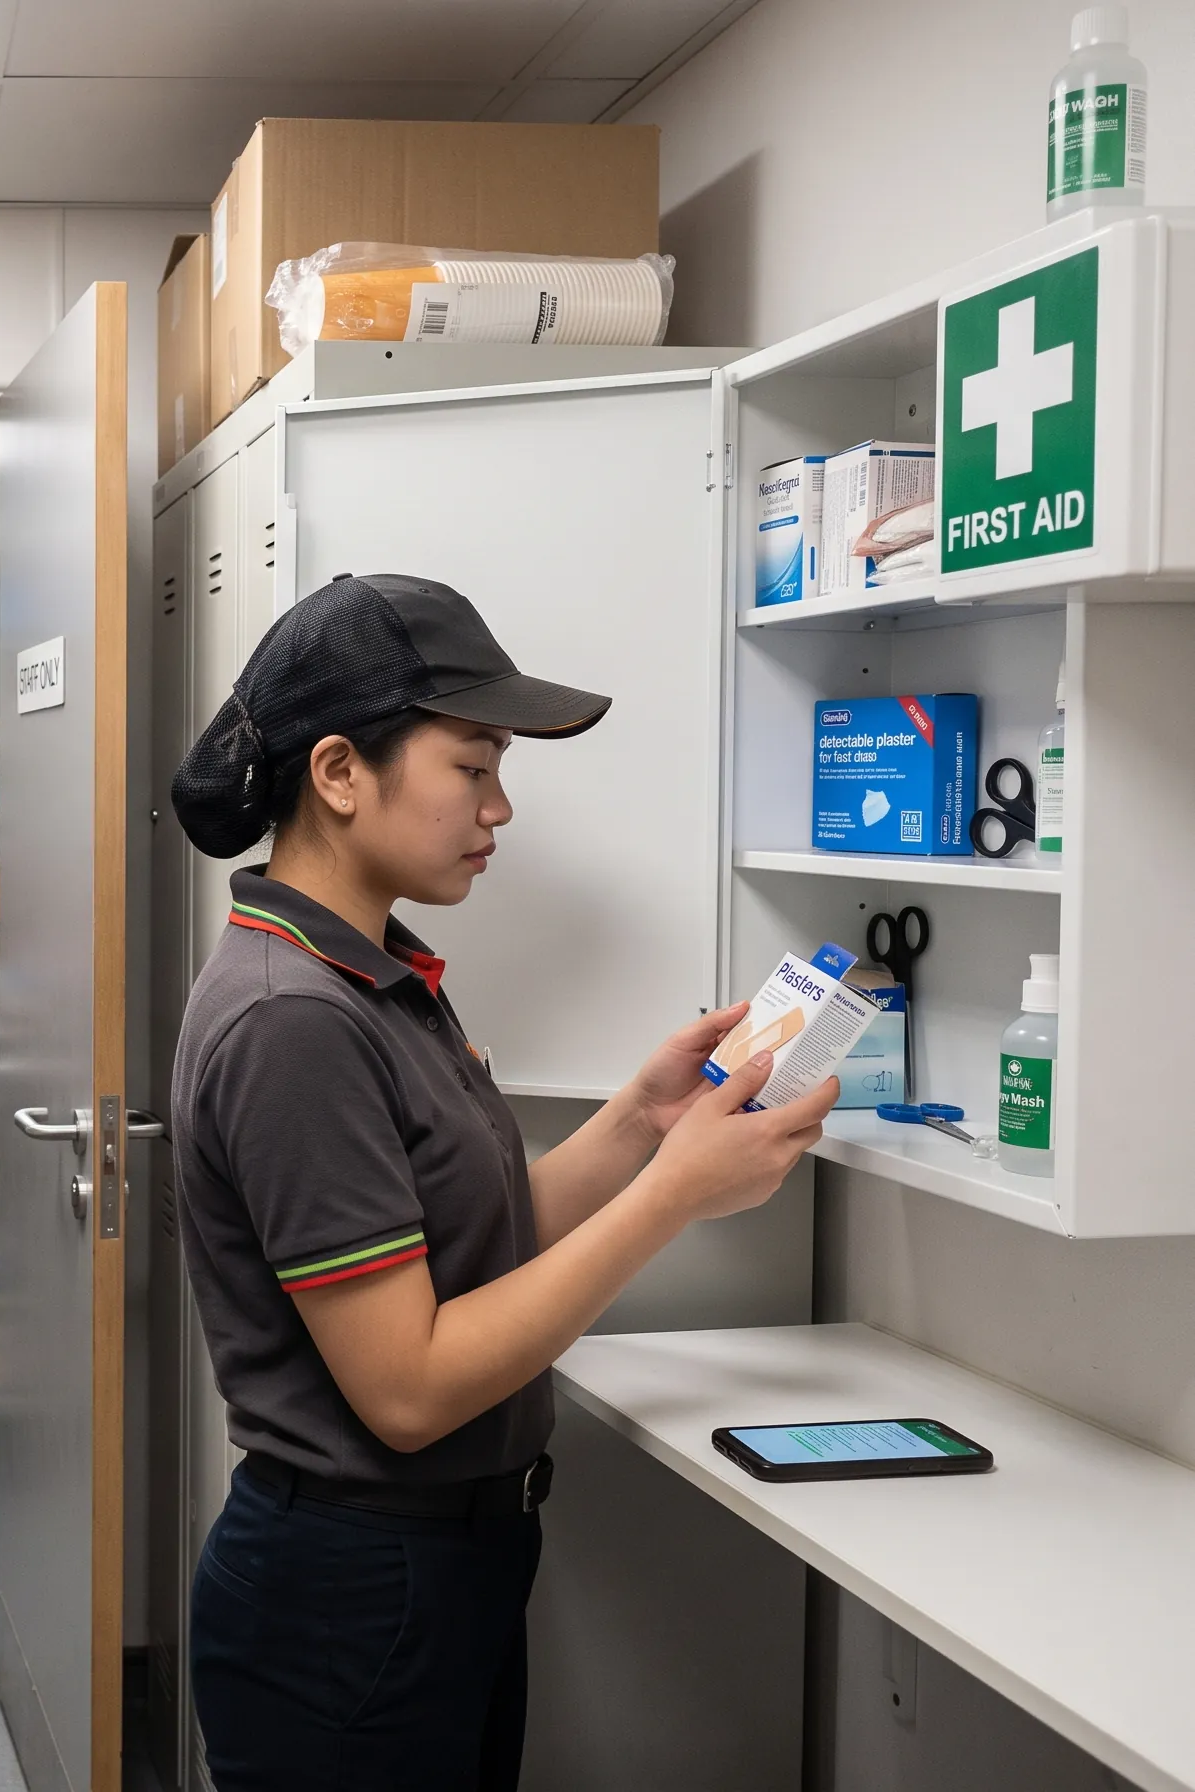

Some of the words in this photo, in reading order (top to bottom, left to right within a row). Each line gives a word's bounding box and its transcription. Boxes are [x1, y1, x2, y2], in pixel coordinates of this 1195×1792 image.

[948, 501, 1027, 552] FIRST
[1031, 489, 1085, 536] AID
[39, 656, 60, 690] ONLY
[819, 733, 874, 749] detectable
[876, 732, 916, 750] plaster
[776, 962, 825, 1002] Plasters
[1010, 1092, 1045, 1108] Mash
